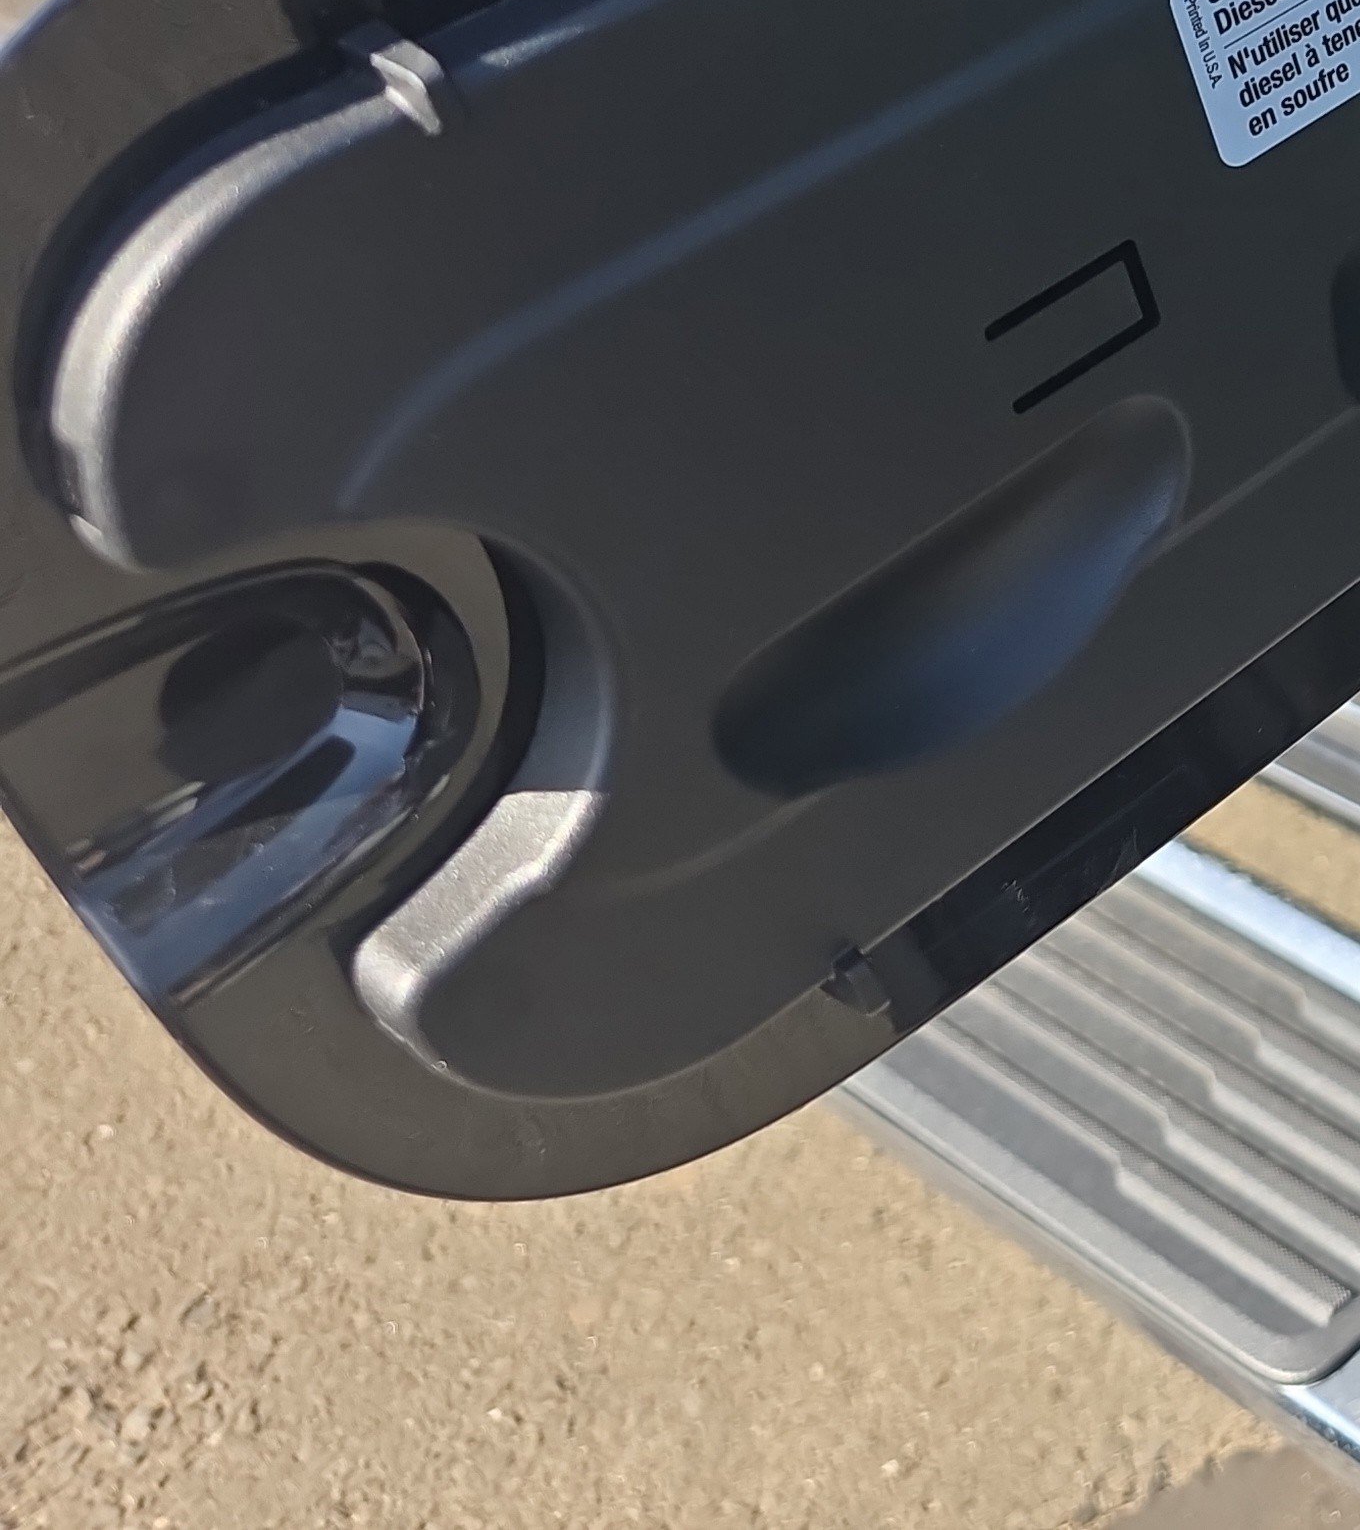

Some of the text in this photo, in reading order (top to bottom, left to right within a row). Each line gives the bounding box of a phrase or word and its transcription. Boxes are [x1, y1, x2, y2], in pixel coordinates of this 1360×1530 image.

[1227, 9, 1321, 80] N'utiliser
[1239, 52, 1302, 108] diesel
[1304, 43, 1321, 68] à
[1248, 61, 1350, 137] en soufre
